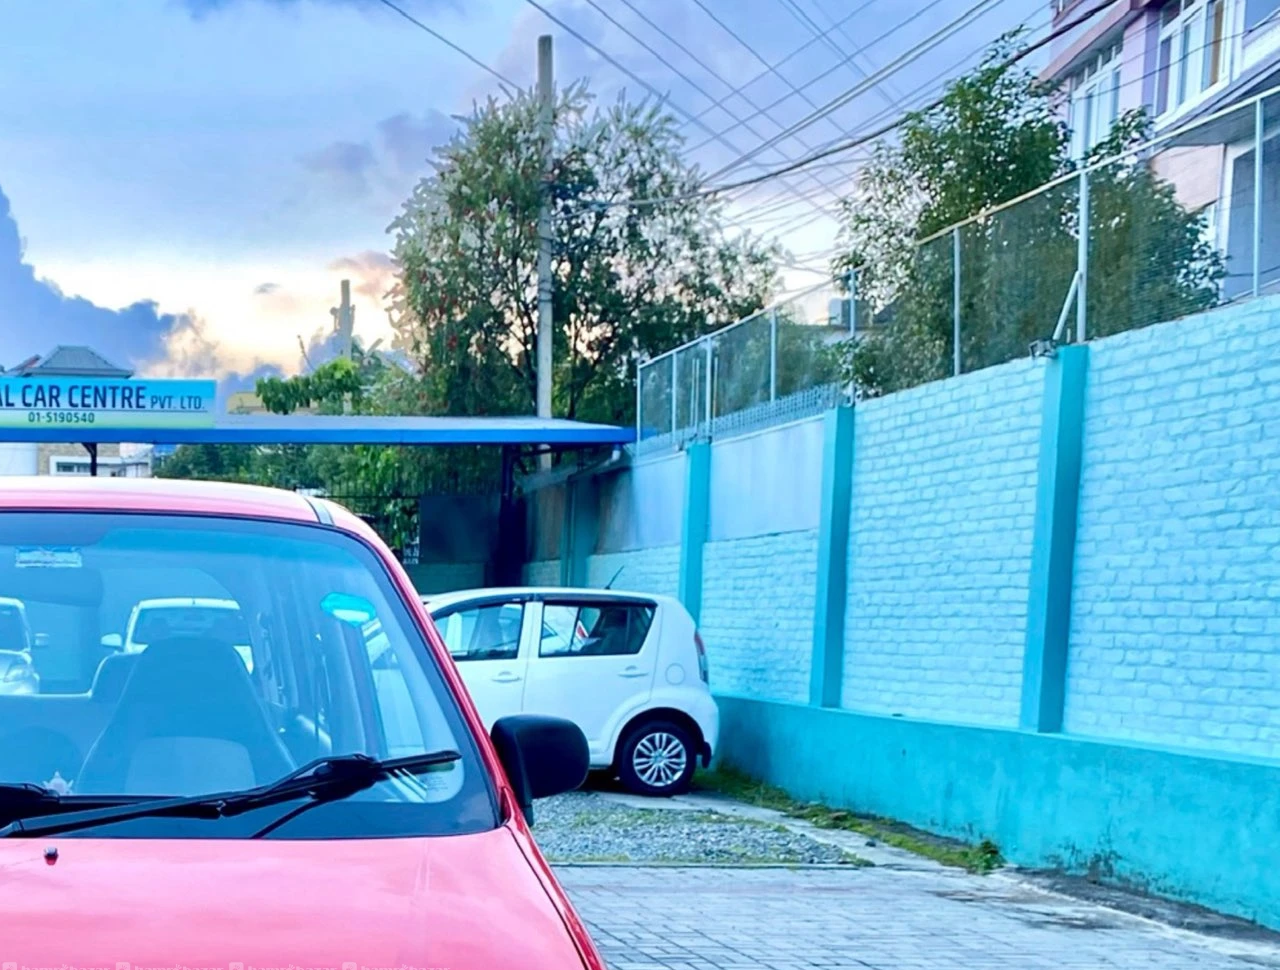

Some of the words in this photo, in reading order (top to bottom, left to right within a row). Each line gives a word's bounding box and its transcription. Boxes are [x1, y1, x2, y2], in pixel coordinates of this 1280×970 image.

[21, 384, 61, 408] CAR
[68, 385, 147, 409] CENTRE
[150, 395, 176, 410] PVT.
[180, 396, 205, 410] LTD.
[28, 411, 95, 424] 01-5190540
